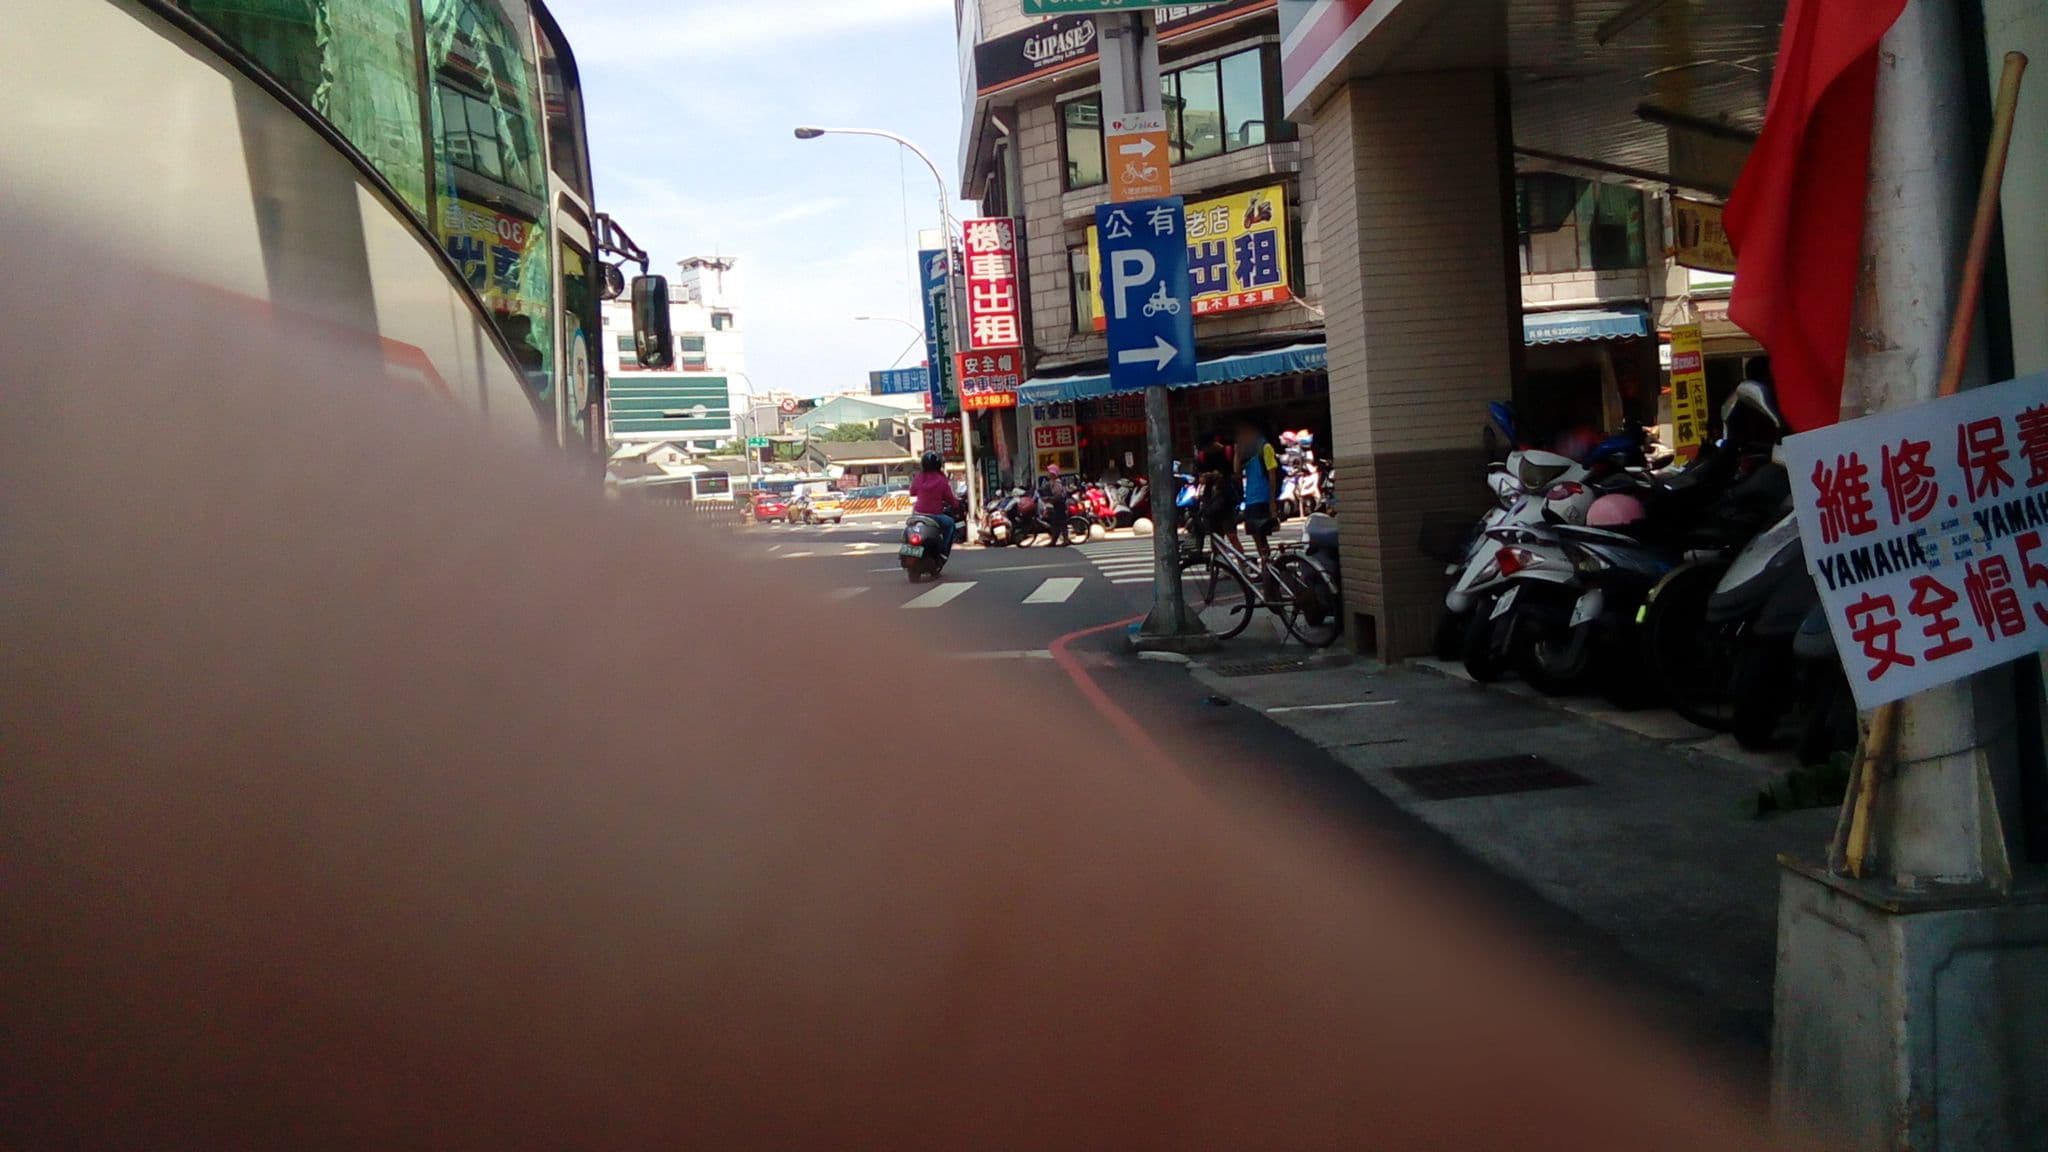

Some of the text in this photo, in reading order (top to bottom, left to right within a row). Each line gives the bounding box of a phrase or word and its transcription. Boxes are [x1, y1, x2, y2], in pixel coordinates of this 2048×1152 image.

[1105, 205, 1176, 240] 公有
[1186, 206, 1230, 238] 老店
[967, 221, 1019, 345] 機車出租
[1111, 249, 1156, 320] P
[1188, 229, 1281, 298] 出租
[1037, 428, 1073, 447] 出租
[1817, 532, 1927, 592] YAMAHA
